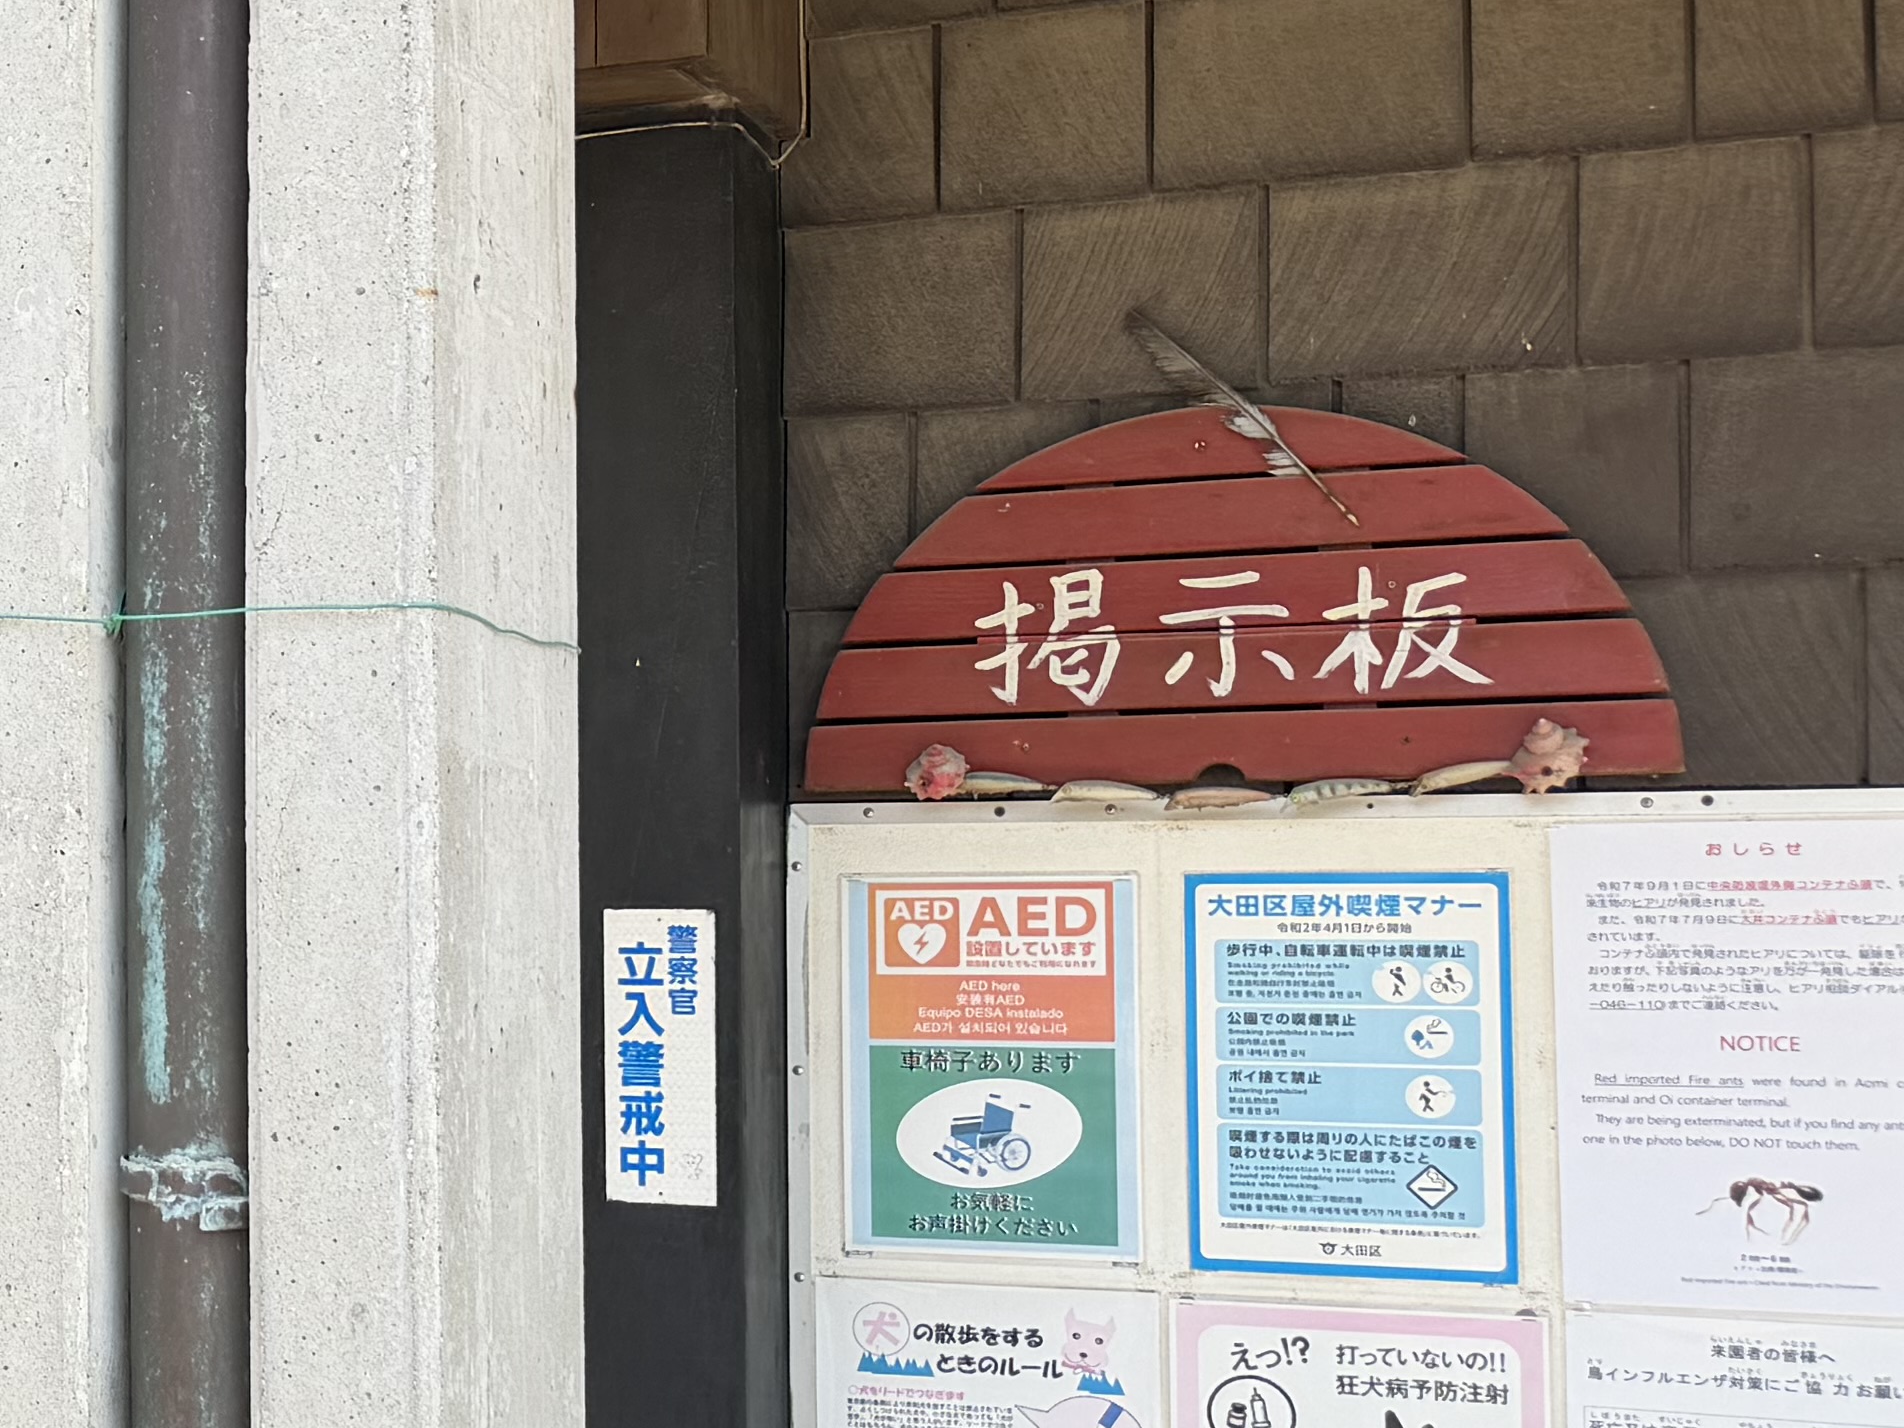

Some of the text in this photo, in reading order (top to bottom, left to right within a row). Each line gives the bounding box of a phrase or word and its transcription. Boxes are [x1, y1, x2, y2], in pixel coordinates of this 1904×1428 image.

[974, 564, 1493, 708] 掲示板
[1705, 842, 1802, 856] おしらせ
[890, 901, 953, 920] AED
[1208, 894, 1482, 917] 大田区屋外喫煙マナー
[966, 896, 1097, 937] AED
[1277, 922, 1412, 934] 令和2年4月1日から開始
[966, 941, 1095, 957] 設置しています
[1226, 943, 1466, 958] 歩行中、自転車運転中は喫煙禁止
[667, 925, 698, 1015] 警察官
[959, 980, 1020, 991] AED here
[918, 1007, 1064, 1019] Equipo DESA instalado
[1227, 1011, 1356, 1027] 公園での喫煙禁止
[1719, 1035, 1801, 1052] NOTICE
[617, 941, 665, 1187] 立入警戒中
[900, 1049, 1081, 1073] 車椅子あります
[1229, 1070, 1322, 1085] ポイ捨て禁止
[1594, 1073, 1617, 1085] Red
[1625, 1075, 1680, 1087] imported
[1688, 1076, 1710, 1086] Fire
[1719, 1077, 1744, 1087] ants
[1752, 1078, 1782, 1087] were
[1790, 1077, 1826, 1088] found
[1835, 1077, 1846, 1088] in
[1582, 1094, 1790, 1108] terminal and Oi container terminal.
[1596, 1113, 1622, 1126] They
[1625, 1116, 1643, 1125] are
[1647, 1115, 1681, 1128] being
[1684, 1116, 1766, 1128] exterminated,
[1770, 1117, 1790, 1128] but
[1804, 1119, 1827, 1131] you
[1858, 1121, 1880, 1133] any
[1583, 1134, 1860, 1151] one in the photo below, DO NOT touch them.
[950, 1191, 1035, 1212] お気軽に
[908, 1214, 1078, 1237] お声掛けください
[1340, 1244, 1382, 1257] 大田区
[913, 1323, 1044, 1348] の散歩をする
[1336, 1344, 1507, 1373] 打っていないの!!
[1710, 1344, 1836, 1364] 来園者の皆様へ
[936, 1355, 1064, 1379] ときのルール
[1336, 1375, 1509, 1406] 狂犬病予防注射
